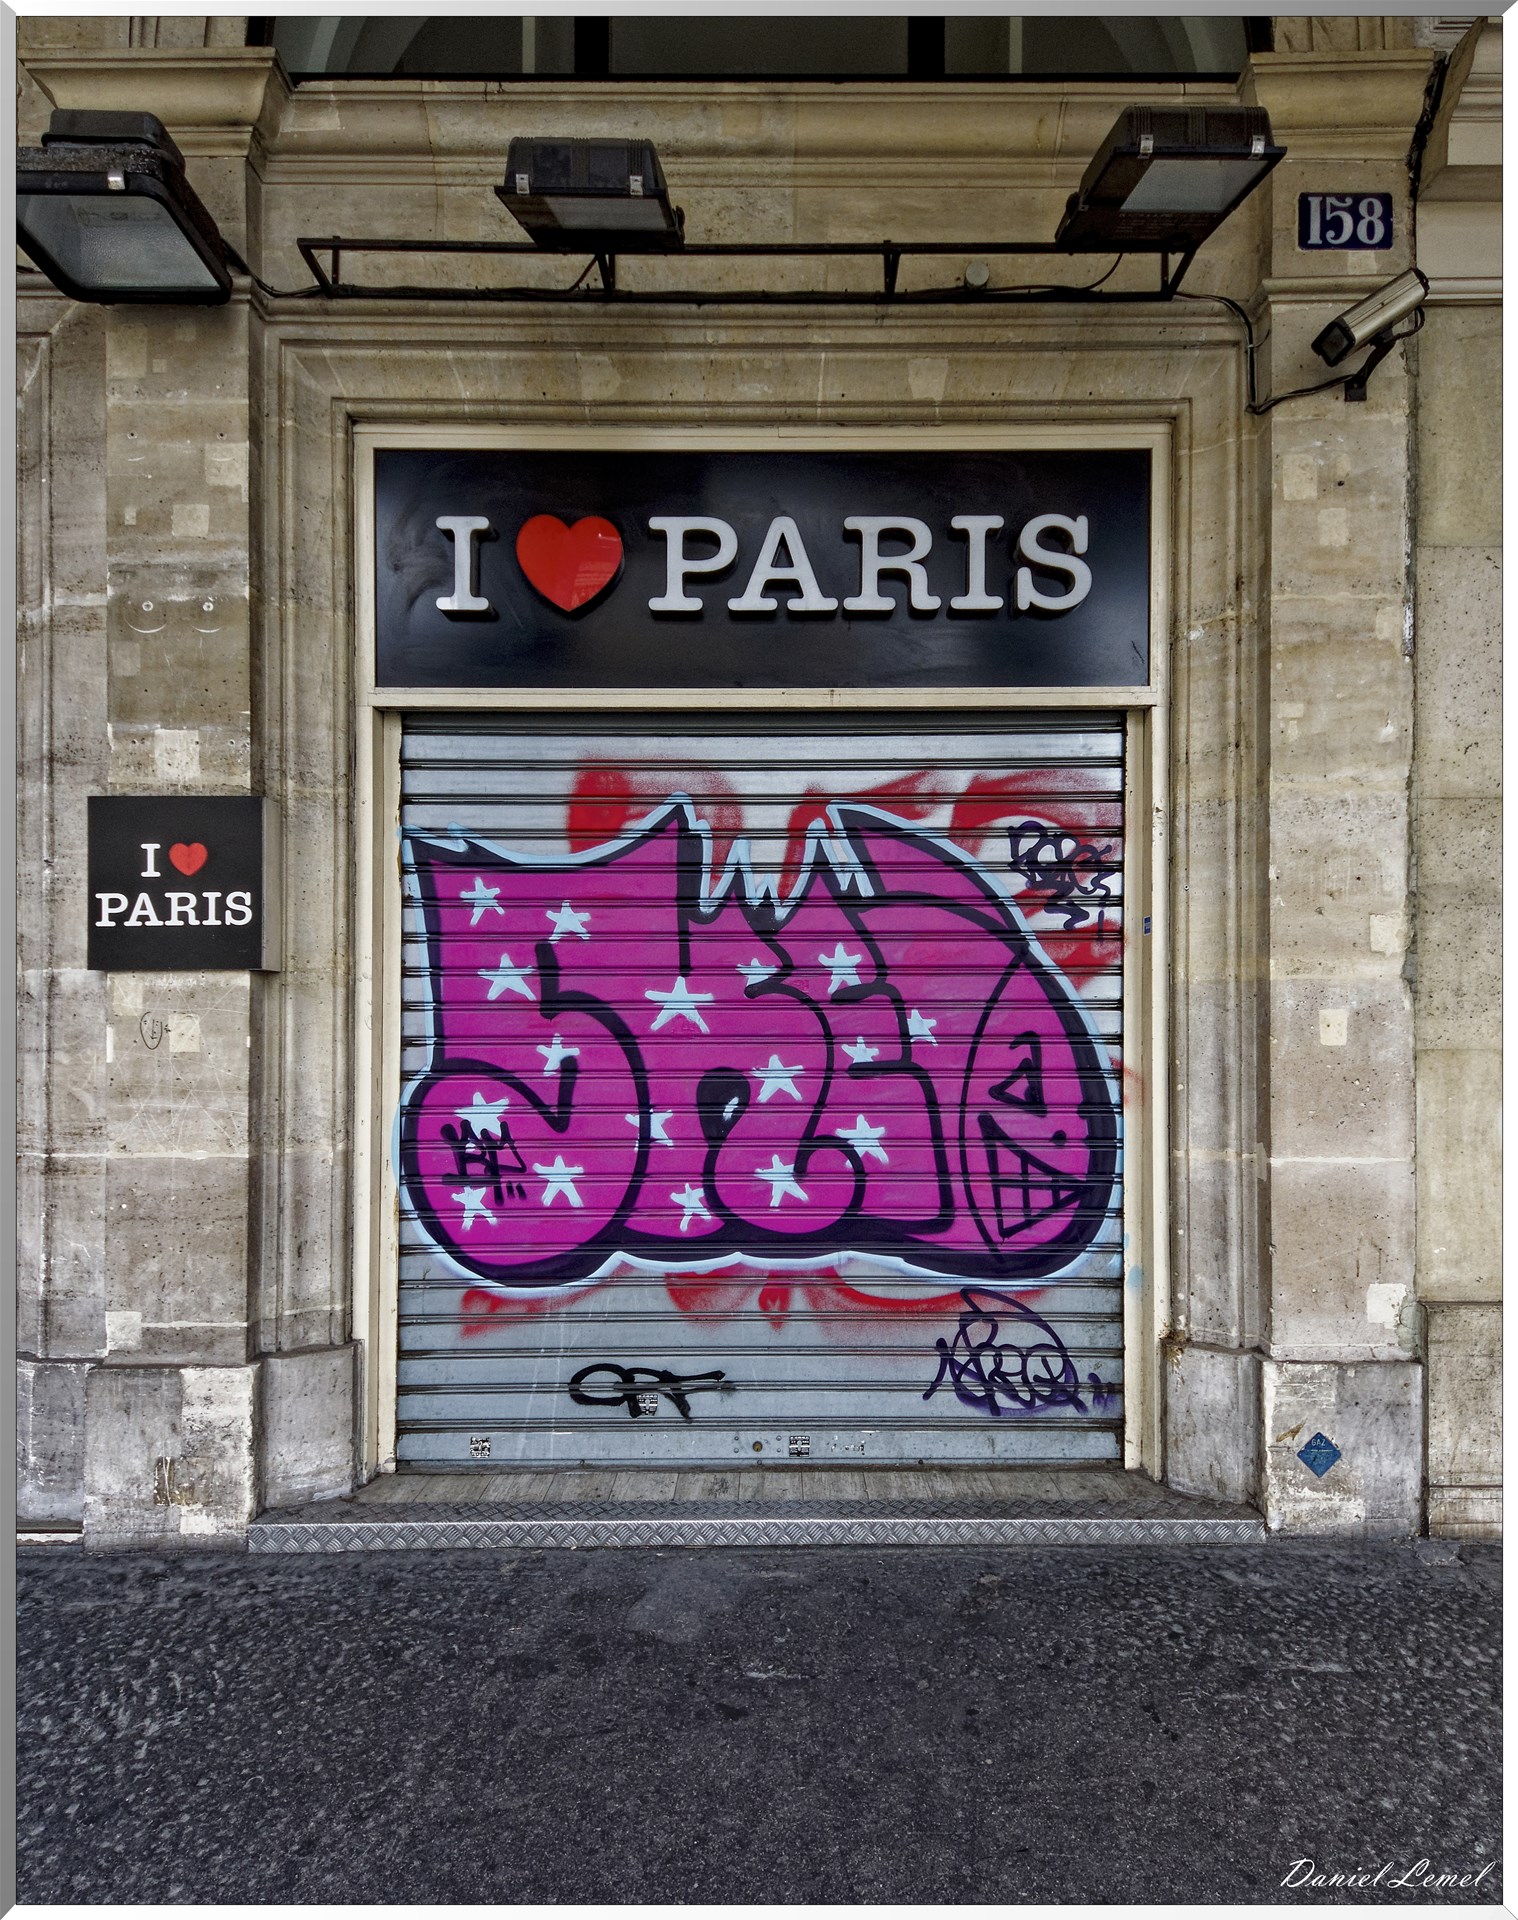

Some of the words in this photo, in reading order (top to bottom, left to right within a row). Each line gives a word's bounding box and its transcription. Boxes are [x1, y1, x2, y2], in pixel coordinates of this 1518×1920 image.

[1307, 196, 1385, 244] 158
[435, 515, 490, 612] I
[647, 513, 1093, 612] PARIS
[140, 843, 161, 877] I
[95, 891, 252, 926] PARIS
[1311, 1438, 1326, 1446] GAZ
